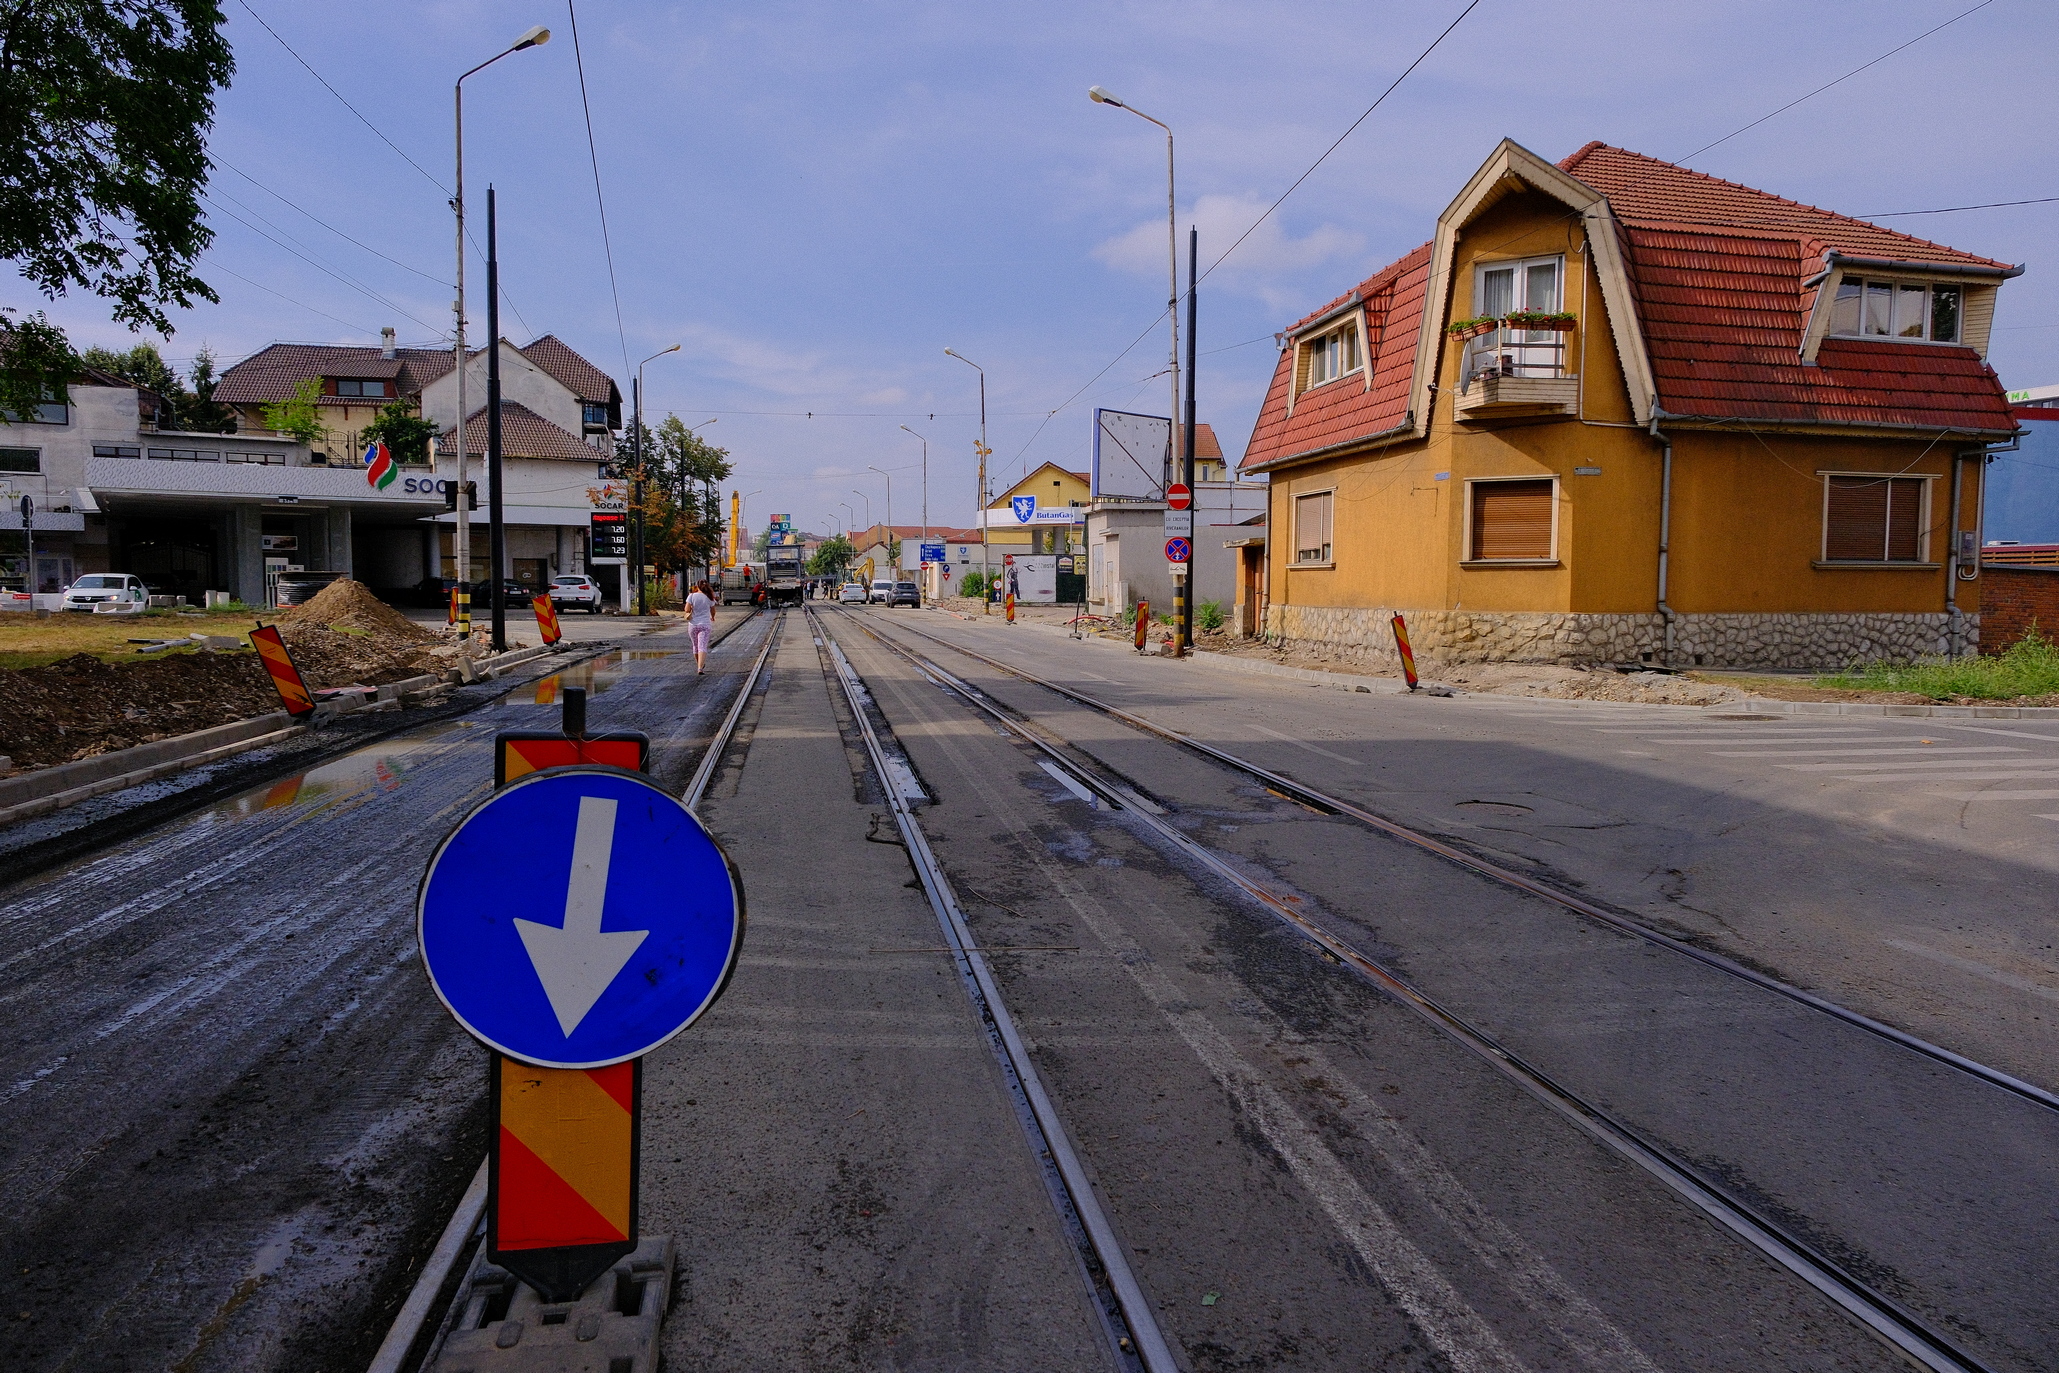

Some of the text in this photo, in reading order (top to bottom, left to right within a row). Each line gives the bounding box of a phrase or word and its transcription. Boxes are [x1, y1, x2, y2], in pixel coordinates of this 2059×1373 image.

[404, 478, 447, 494] SOC
[594, 502, 624, 510] SOCAR
[1036, 511, 1074, 519] ButanGas
[612, 536, 625, 544] 7.60
